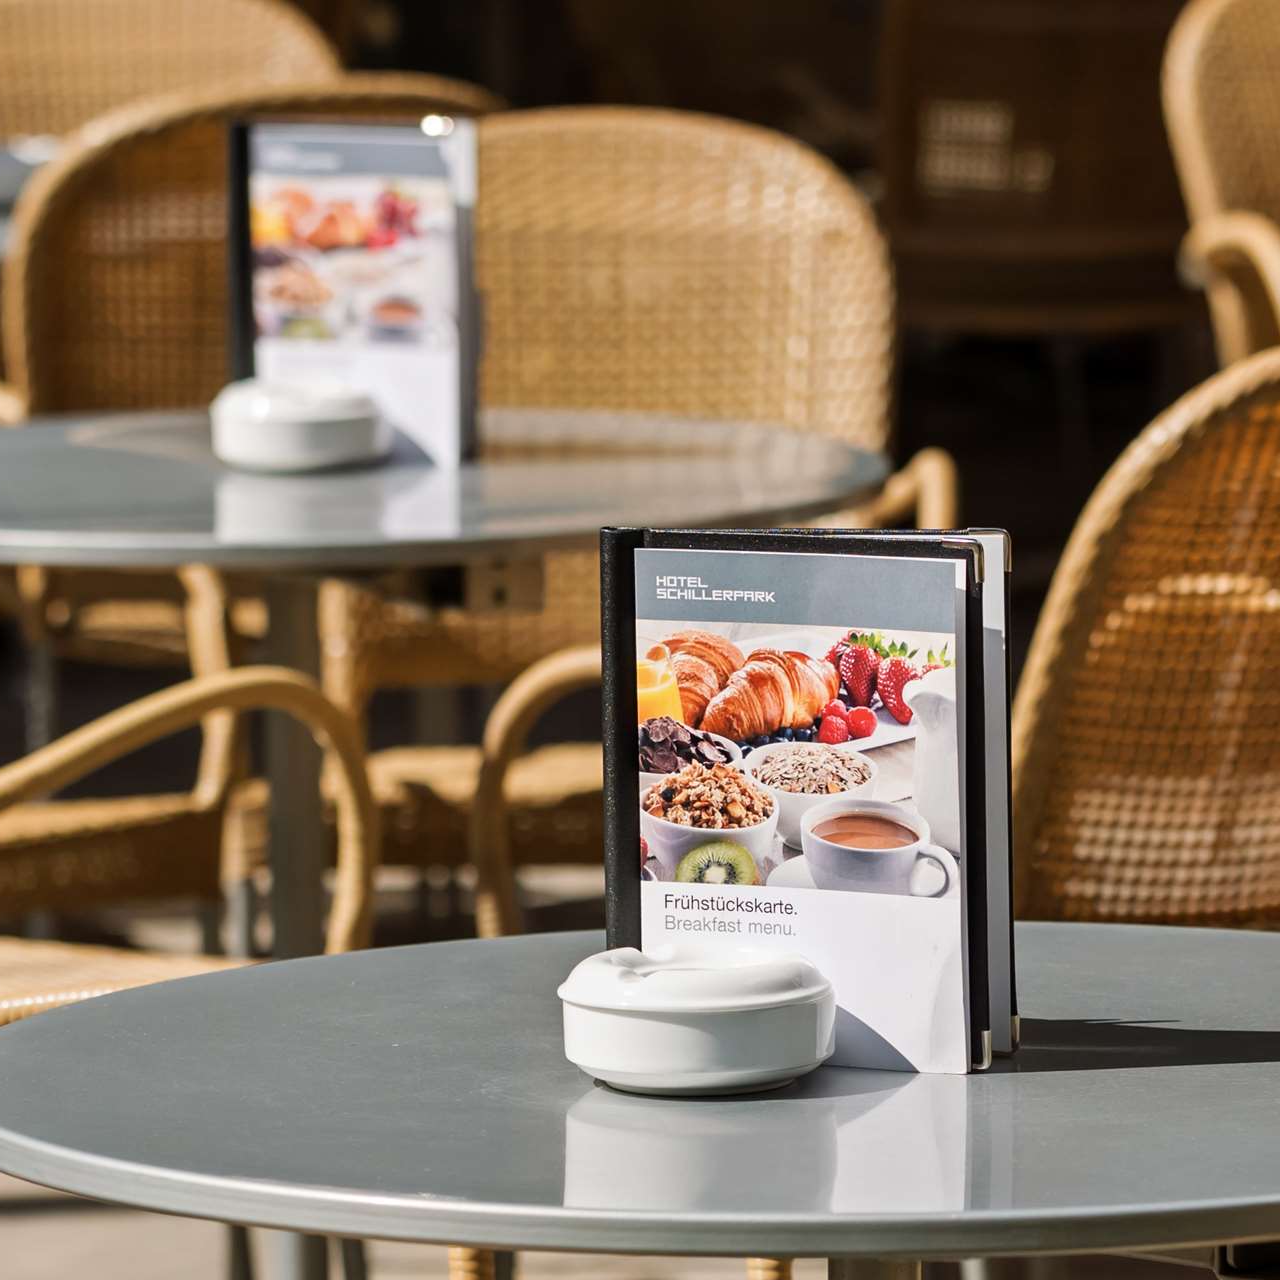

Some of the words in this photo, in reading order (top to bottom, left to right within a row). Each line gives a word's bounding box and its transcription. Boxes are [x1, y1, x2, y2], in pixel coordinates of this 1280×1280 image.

[656, 575, 708, 588] HOTEL
[656, 588, 776, 603] SCHILLERPARK
[664, 894, 798, 916] Frühstückskarte.
[664, 915, 742, 934] Breakfast
[748, 920, 797, 937] menu.
